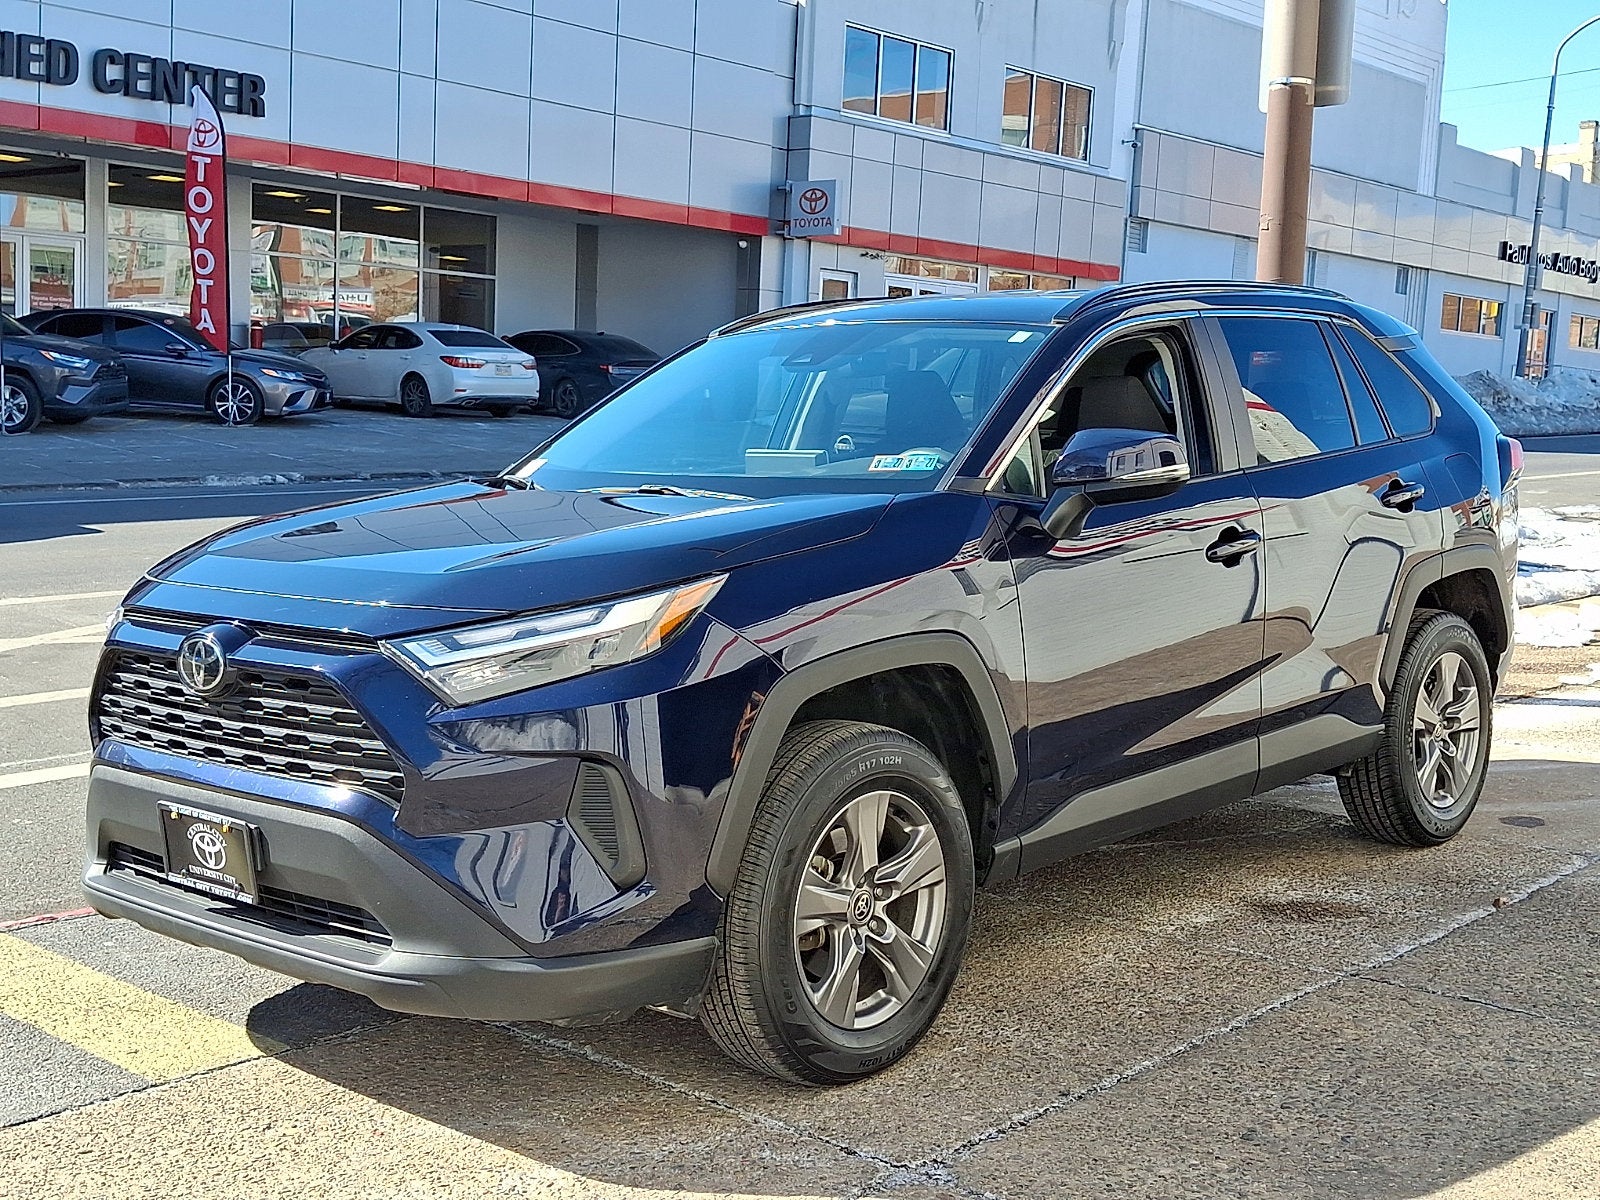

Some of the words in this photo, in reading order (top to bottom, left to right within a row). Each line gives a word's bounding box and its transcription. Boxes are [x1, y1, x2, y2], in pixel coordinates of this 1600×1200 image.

[92, 48, 266, 118] CENTER
[793, 216, 833, 229] TOYOTA
[187, 155, 217, 334] TOYOTA
[1536, 252, 1556, 271] ros.
[1552, 252, 1581, 275] Auto
[880, 756, 902, 765] 102H
[187, 823, 212, 841] CENTRAL
[211, 826, 228, 847] CITY
[188, 864, 224, 881] UNIVERSITY
[224, 873, 236, 885] CITY
